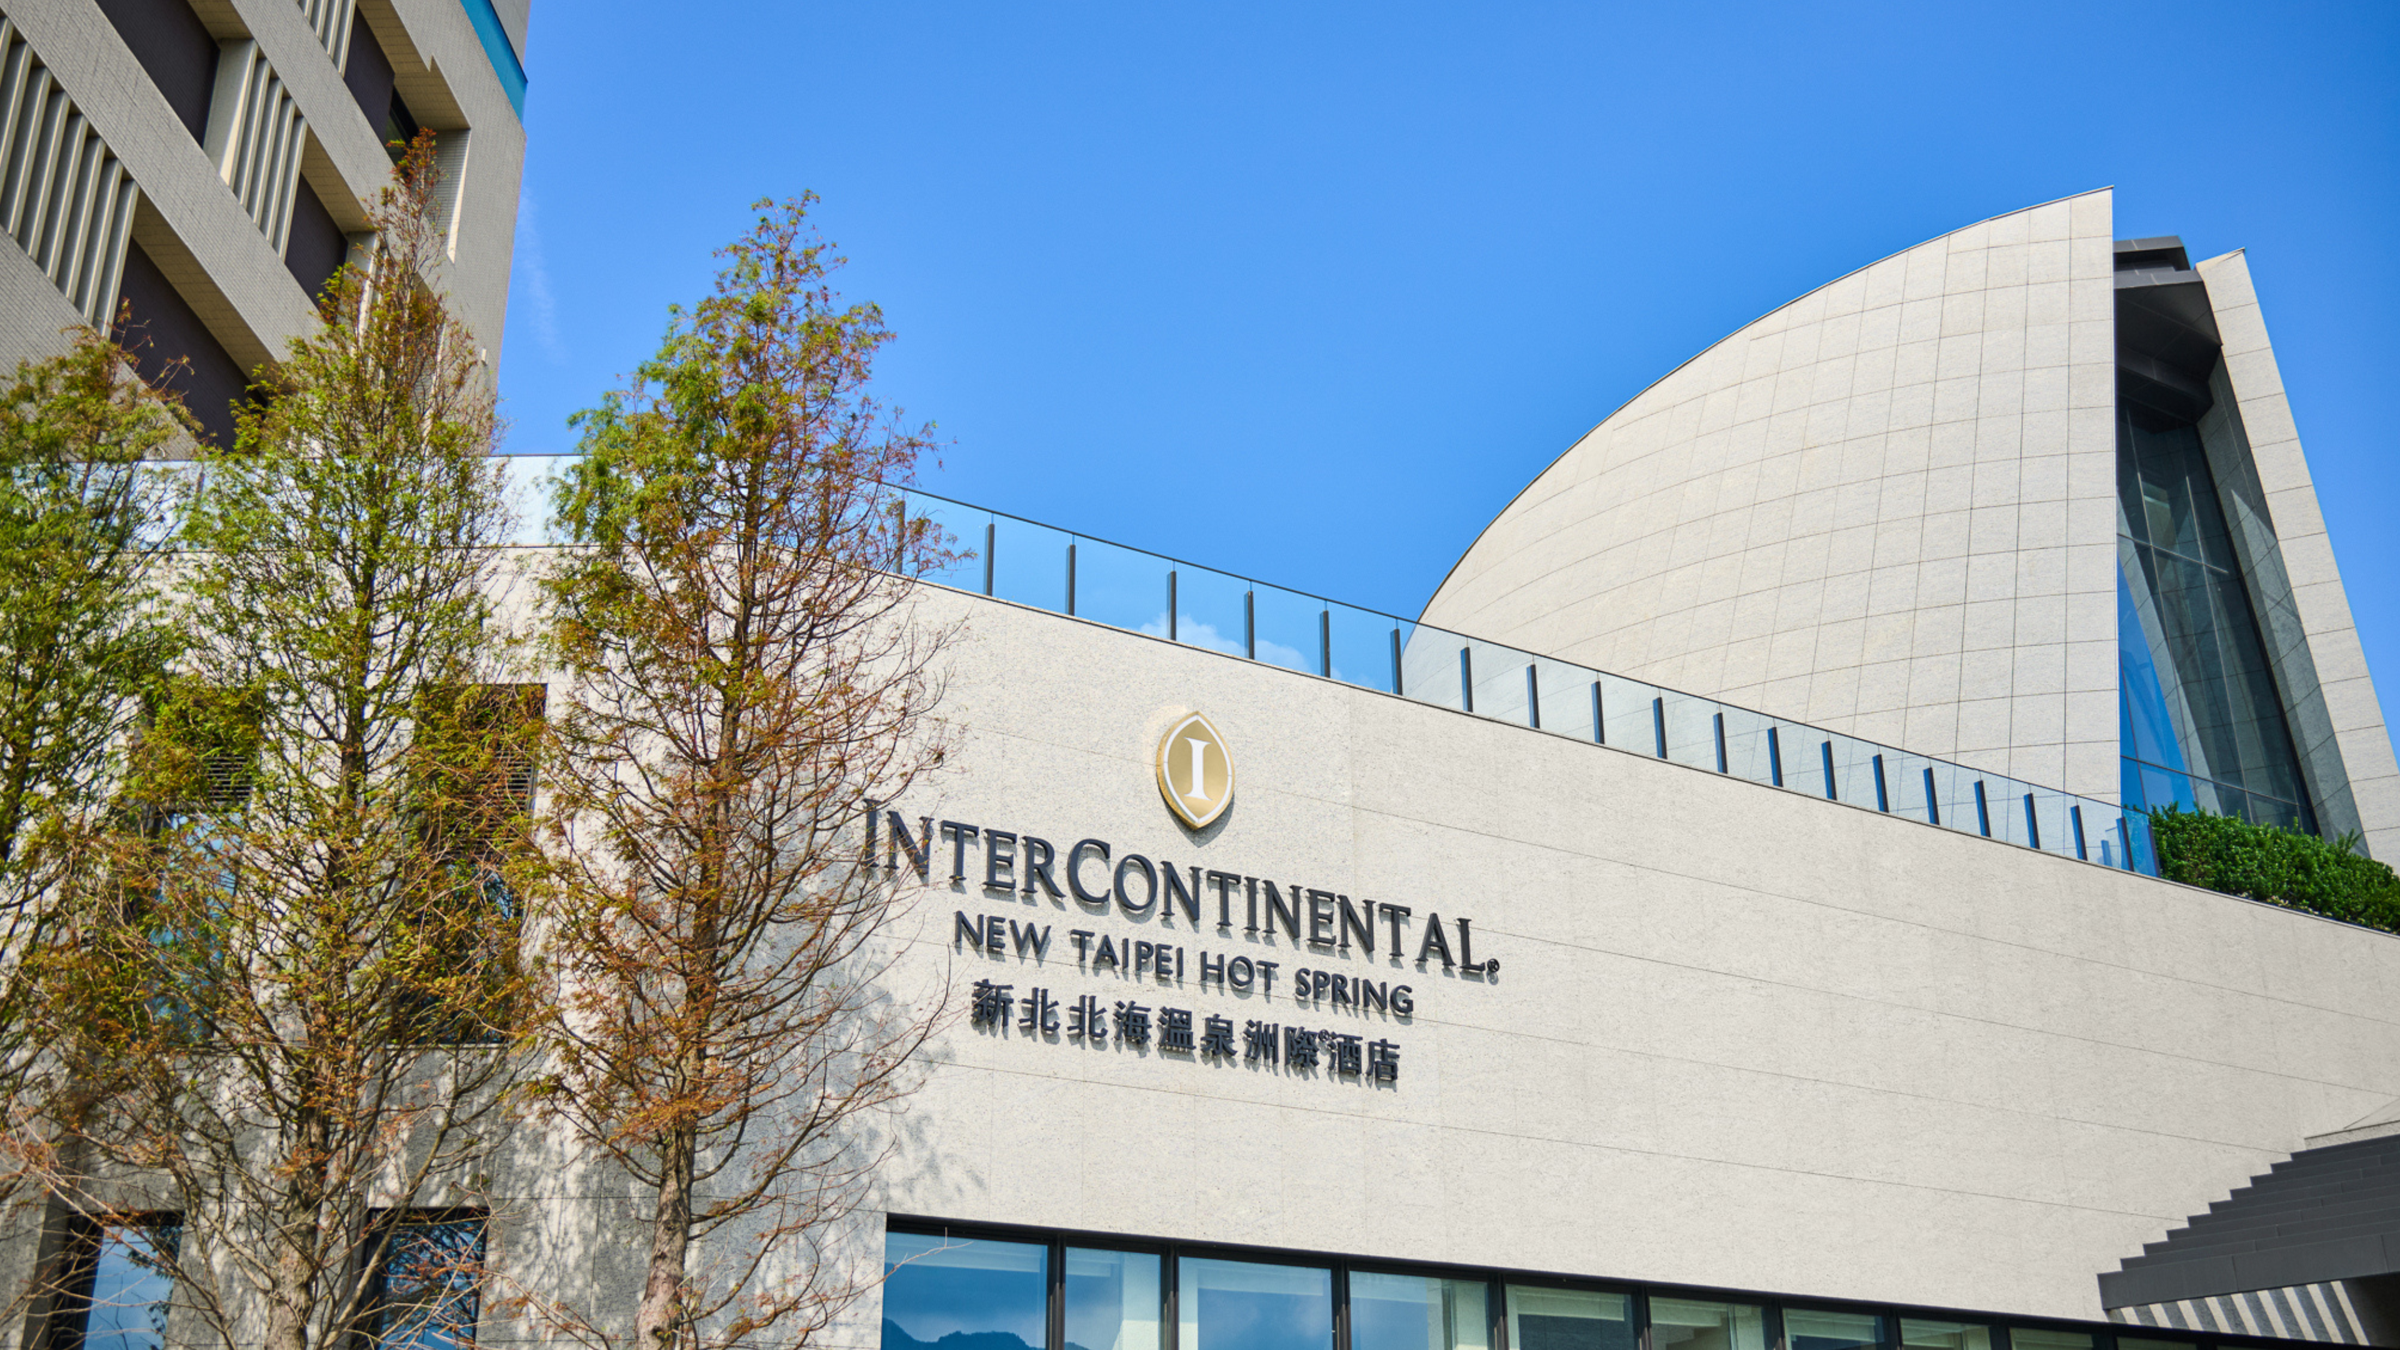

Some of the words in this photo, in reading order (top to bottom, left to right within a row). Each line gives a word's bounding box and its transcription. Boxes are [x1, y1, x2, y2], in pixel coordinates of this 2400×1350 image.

[955, 911, 1051, 955] NEW
[1069, 928, 1184, 977] TAIPEI
[1200, 950, 1280, 992] HOT
[1295, 967, 1414, 1014] SPRING
